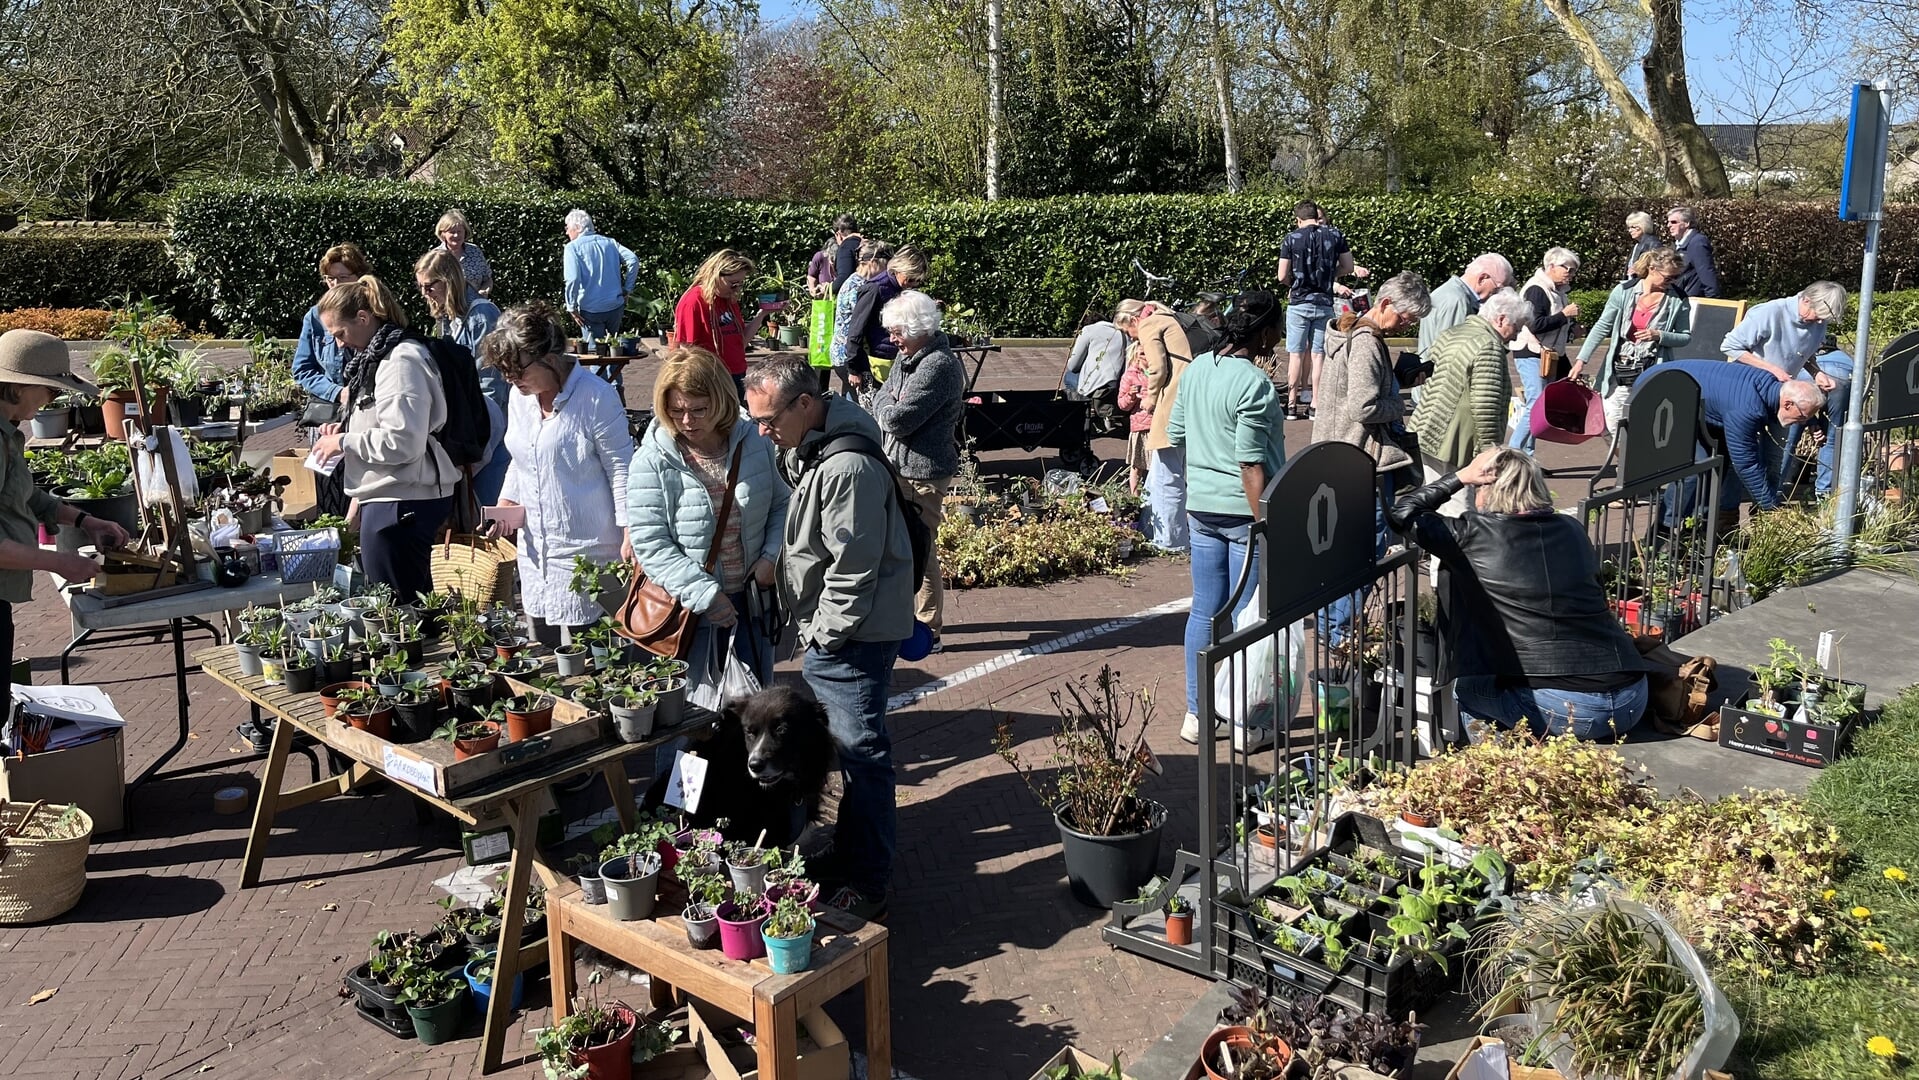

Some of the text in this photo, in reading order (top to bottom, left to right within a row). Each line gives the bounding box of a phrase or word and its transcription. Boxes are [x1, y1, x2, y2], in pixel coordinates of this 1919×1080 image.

[817, 312, 826, 344] PLUS
[1728, 739, 1744, 748] Happy
[1754, 745, 1775, 755] Healthy
